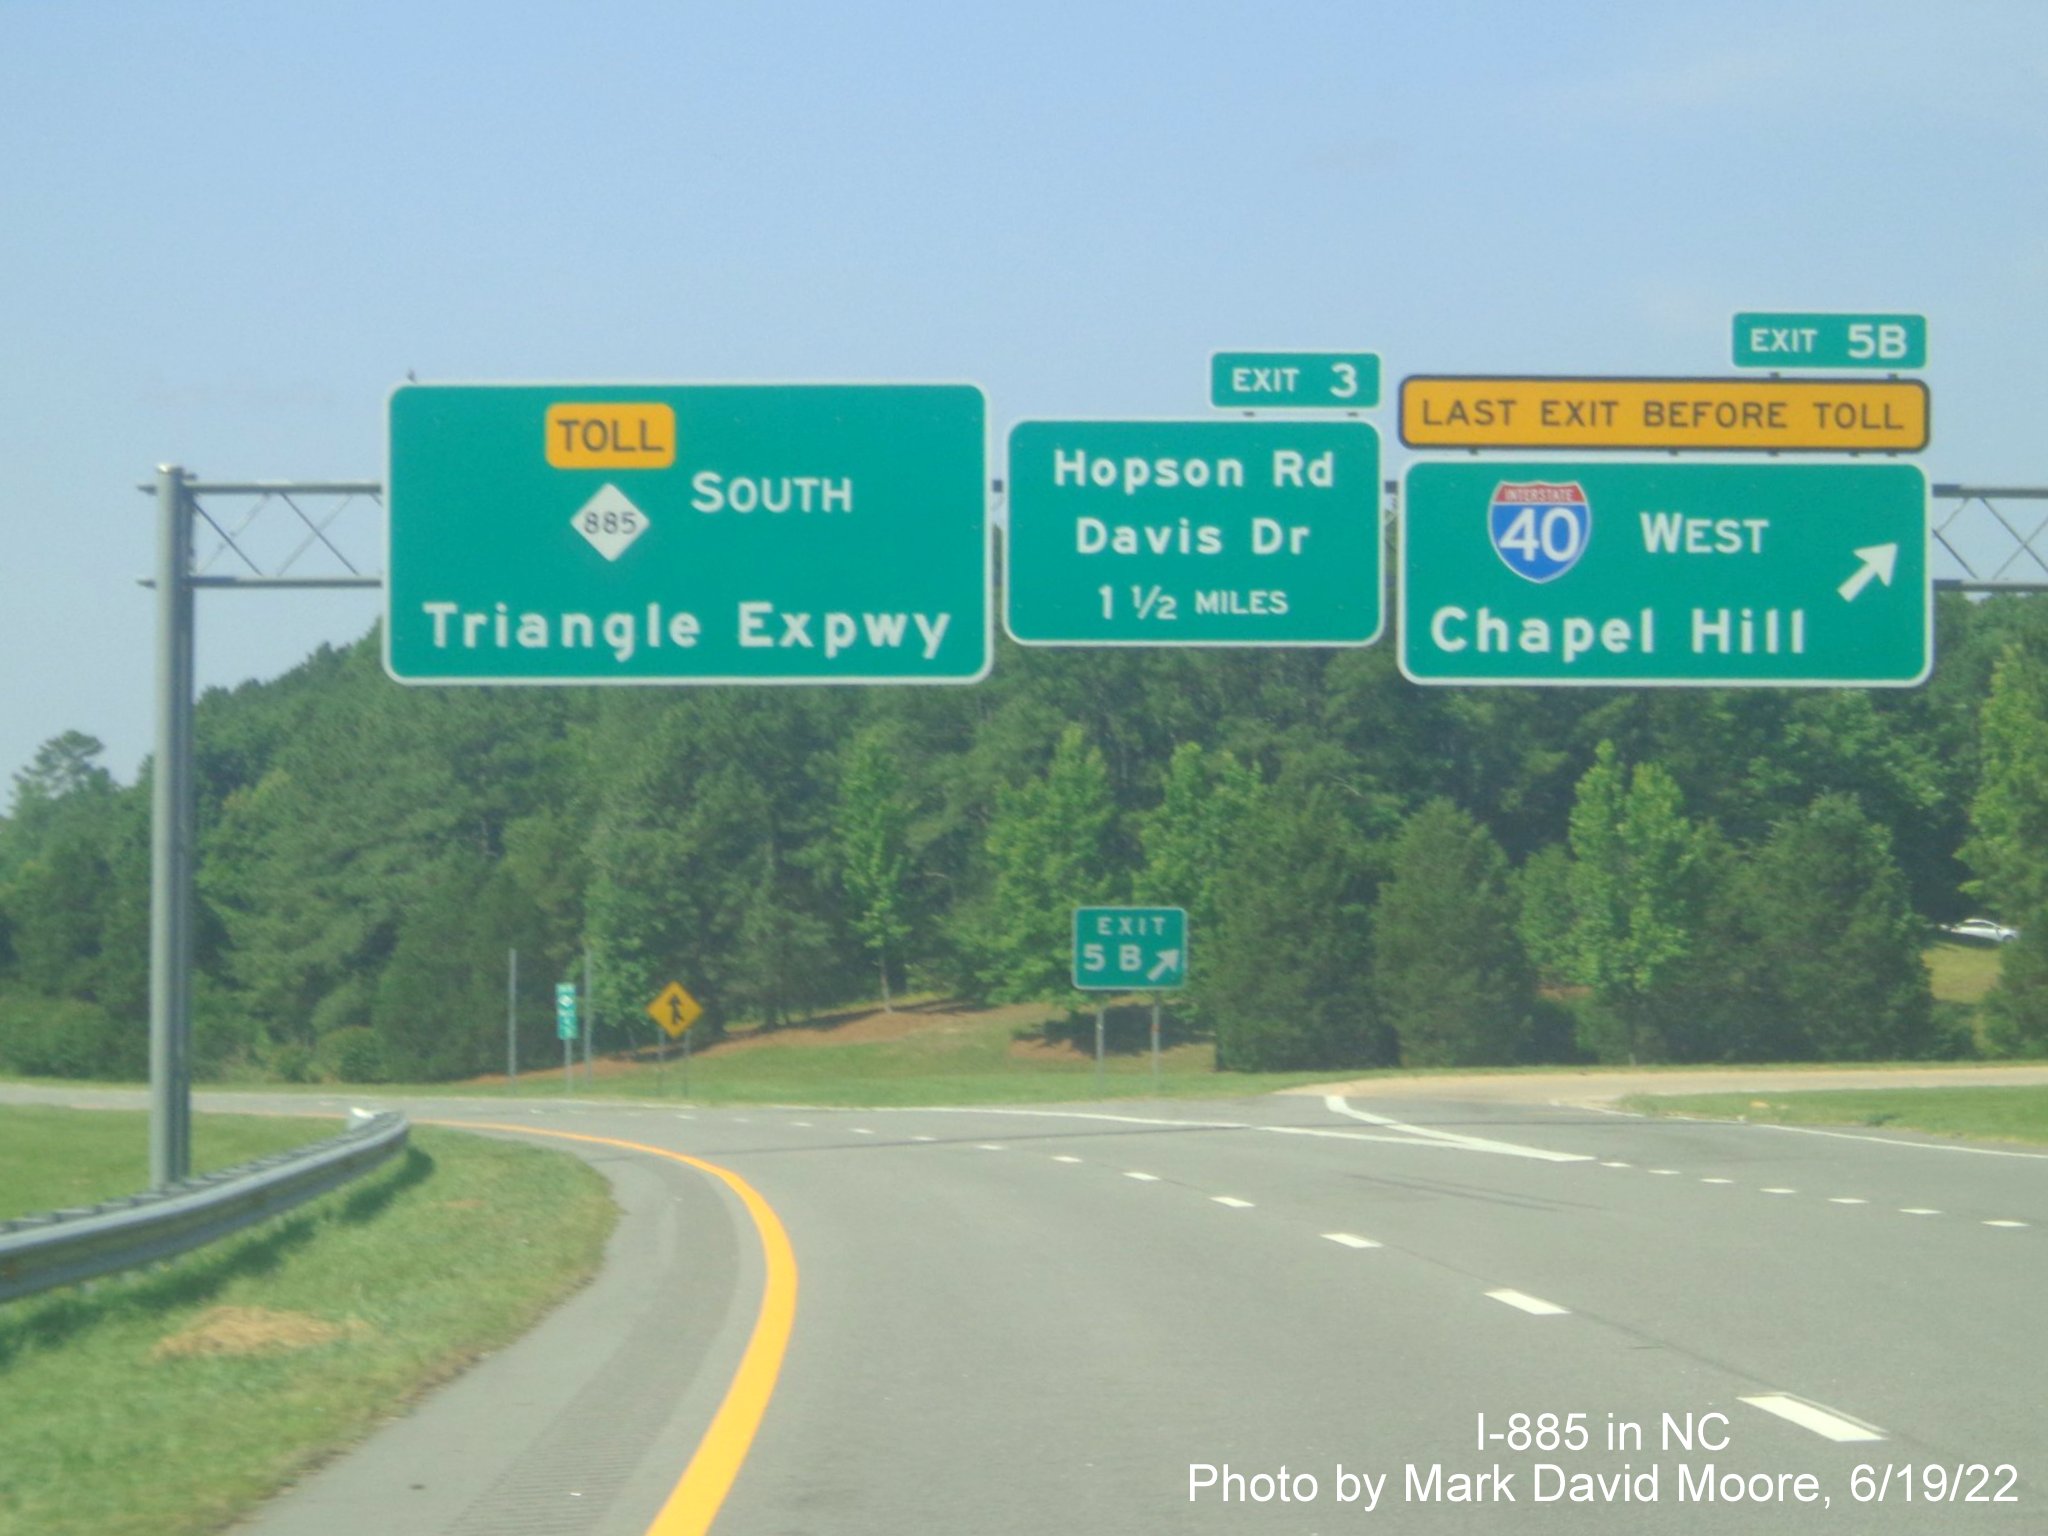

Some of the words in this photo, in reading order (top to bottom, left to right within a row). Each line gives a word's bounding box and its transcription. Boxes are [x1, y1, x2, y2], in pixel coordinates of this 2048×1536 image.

[1750, 328, 1818, 353] EXIT
[1846, 324, 1908, 360] 5B
[1232, 367, 1300, 392] EXIT
[1329, 363, 1358, 398] 3
[1421, 399, 1516, 427] LAST
[1541, 400, 1619, 428] EXIT
[1643, 401, 1788, 429] BEFORE
[1812, 402, 1905, 431] TOLL
[556, 418, 665, 454] TOLL
[1054, 449, 1244, 495] Hopson
[1273, 450, 1334, 487] Rd
[691, 471, 852, 513] SOUTH
[583, 511, 638, 536] 885
[1076, 516, 1223, 555] Davis
[1252, 517, 1310, 555] Dr
[1500, 507, 1579, 562] 40
[1640, 513, 1769, 554] WEST
[1195, 590, 1289, 615] MILES
[423, 602, 702, 662] Triangle
[738, 602, 951, 660] Expwy
[1431, 606, 1654, 664] Chapel
[1691, 608, 1806, 654] Hill
[1097, 917, 1165, 935] EXIT
